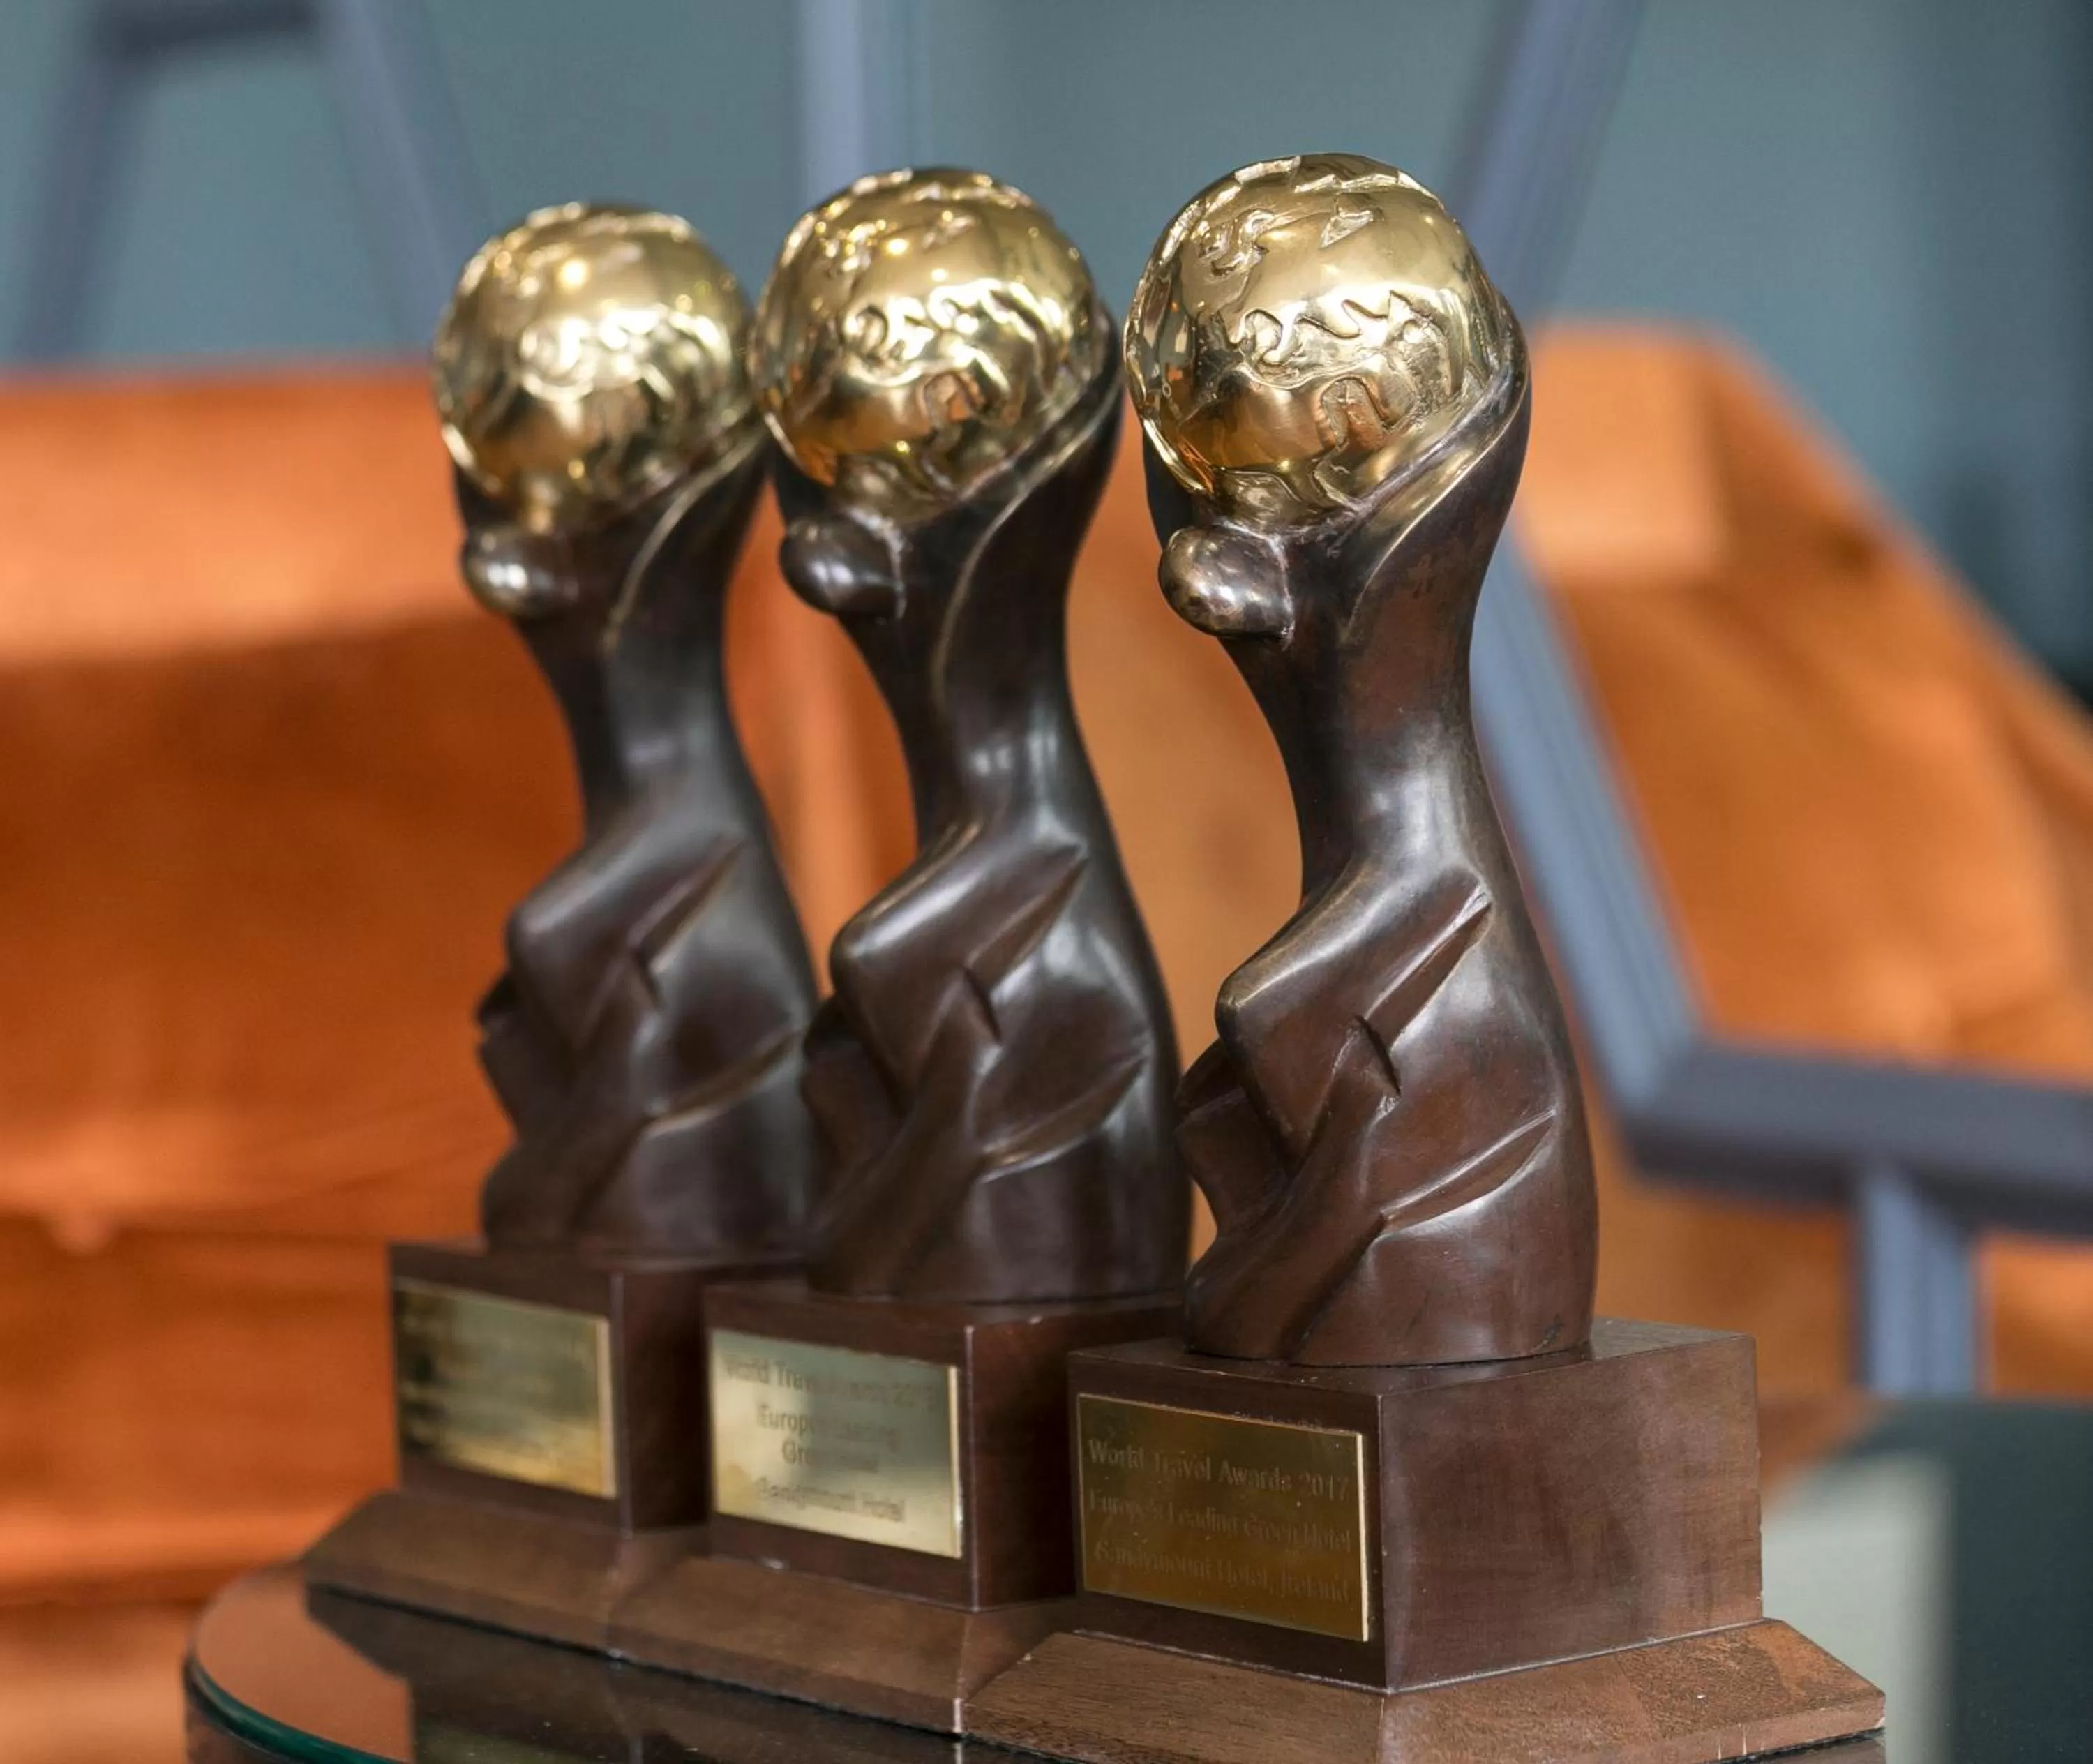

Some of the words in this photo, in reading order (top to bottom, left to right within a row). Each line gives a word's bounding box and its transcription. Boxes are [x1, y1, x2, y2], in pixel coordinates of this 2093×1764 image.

[1088, 1439, 1144, 1469] World
[1155, 1451, 1211, 1481] Travel
[1218, 1459, 1291, 1491] Awards
